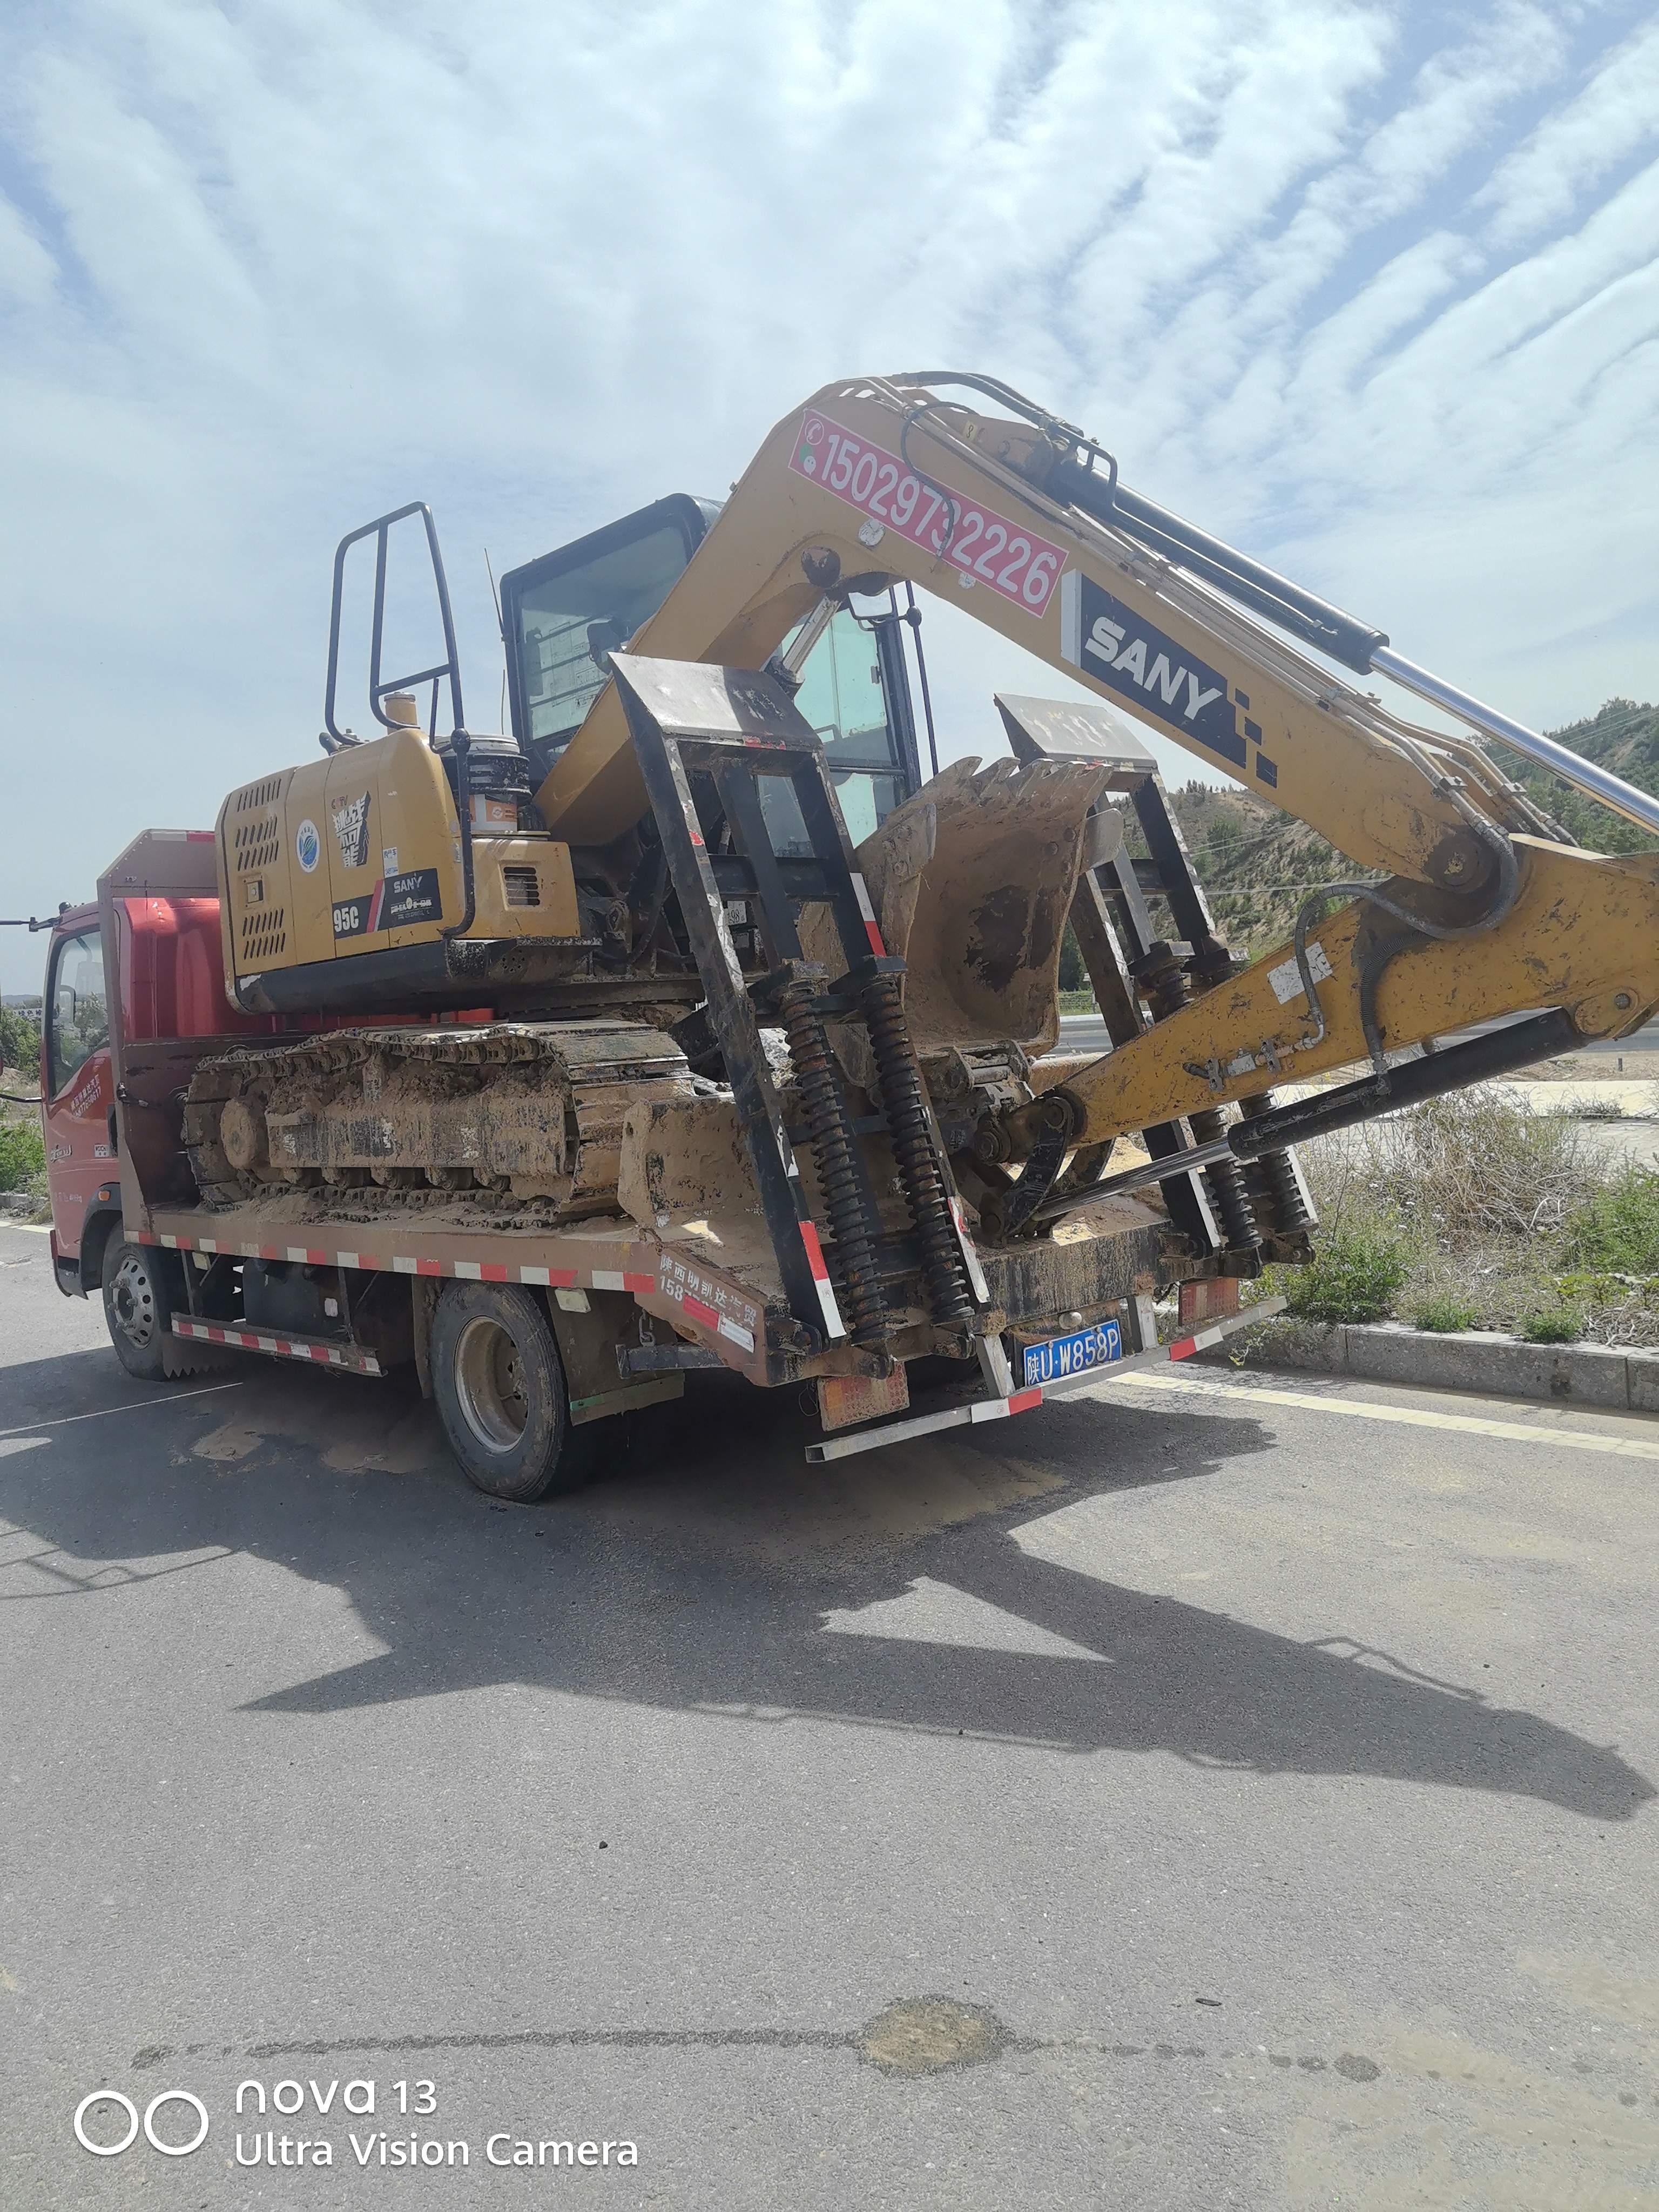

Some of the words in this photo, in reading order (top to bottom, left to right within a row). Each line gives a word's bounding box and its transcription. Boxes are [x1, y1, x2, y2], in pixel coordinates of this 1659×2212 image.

[821, 434, 1058, 605] 15029732226
[1084, 616, 1223, 720] SANY
[393, 875, 423, 894] SANY
[333, 906, 360, 933] 95C
[1027, 1327, 1119, 1386] 陕U·W858P
